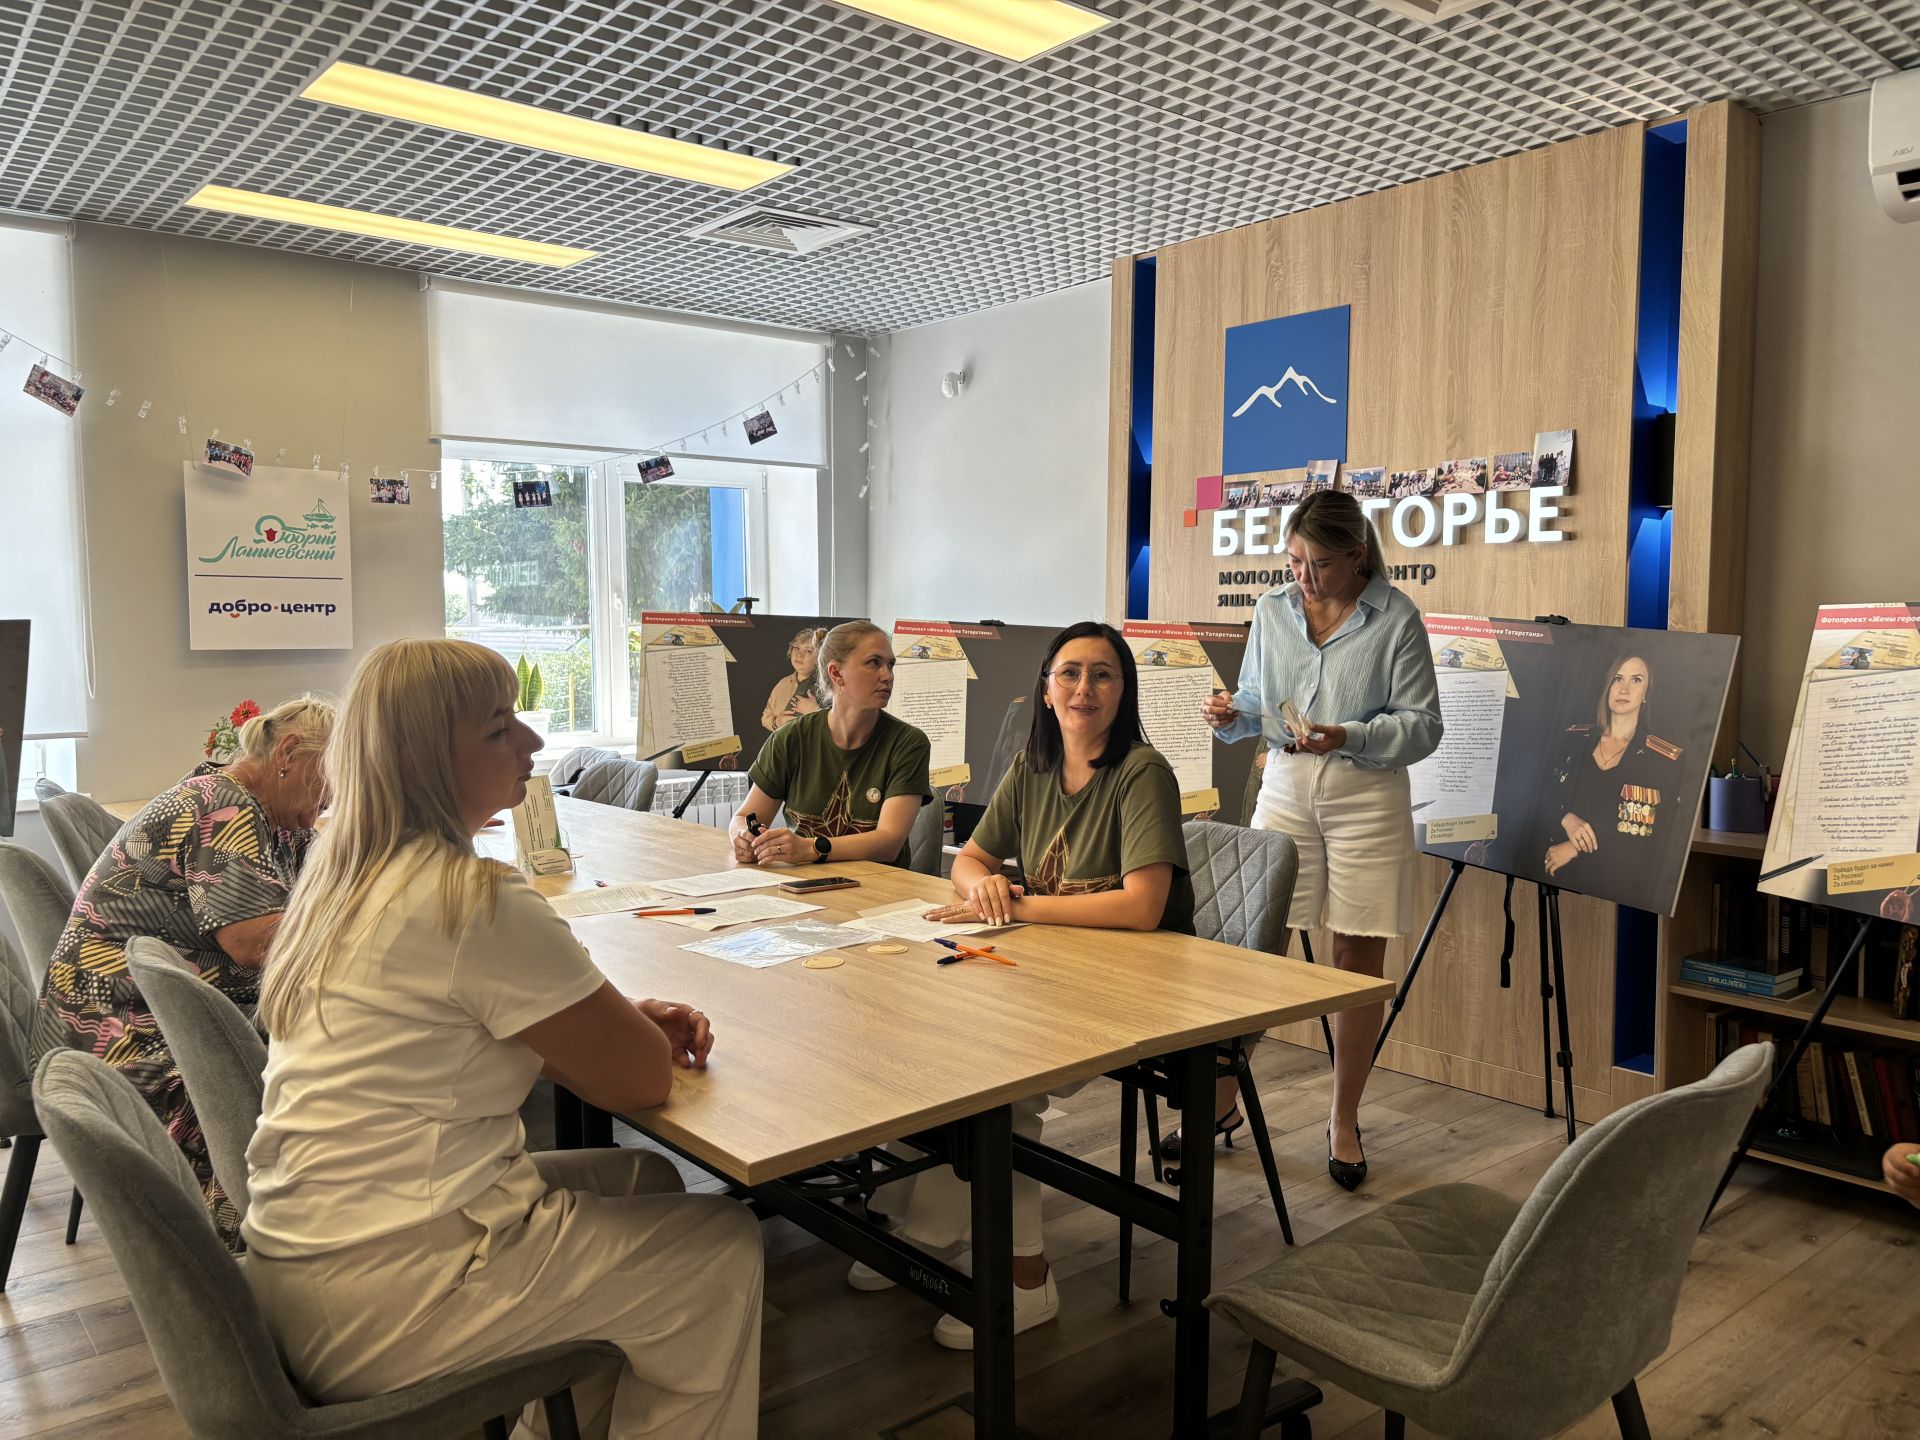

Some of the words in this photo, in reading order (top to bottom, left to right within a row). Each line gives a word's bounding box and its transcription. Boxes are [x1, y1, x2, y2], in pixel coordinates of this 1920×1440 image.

[1212, 484, 1564, 556] БЕЛГОРЬЕ
[198, 535, 337, 564] Лаишевский
[1218, 563, 1296, 587] молодё
[1821, 615, 1867, 624] Фотопроект
[1868, 615, 1896, 623] «Жены
[1897, 615, 1920, 624] герое
[1426, 623, 1461, 631] Фотопроект
[1505, 629, 1544, 638] Татарстана»
[1707, 975, 1747, 989] ПЕДАГОГИКА
